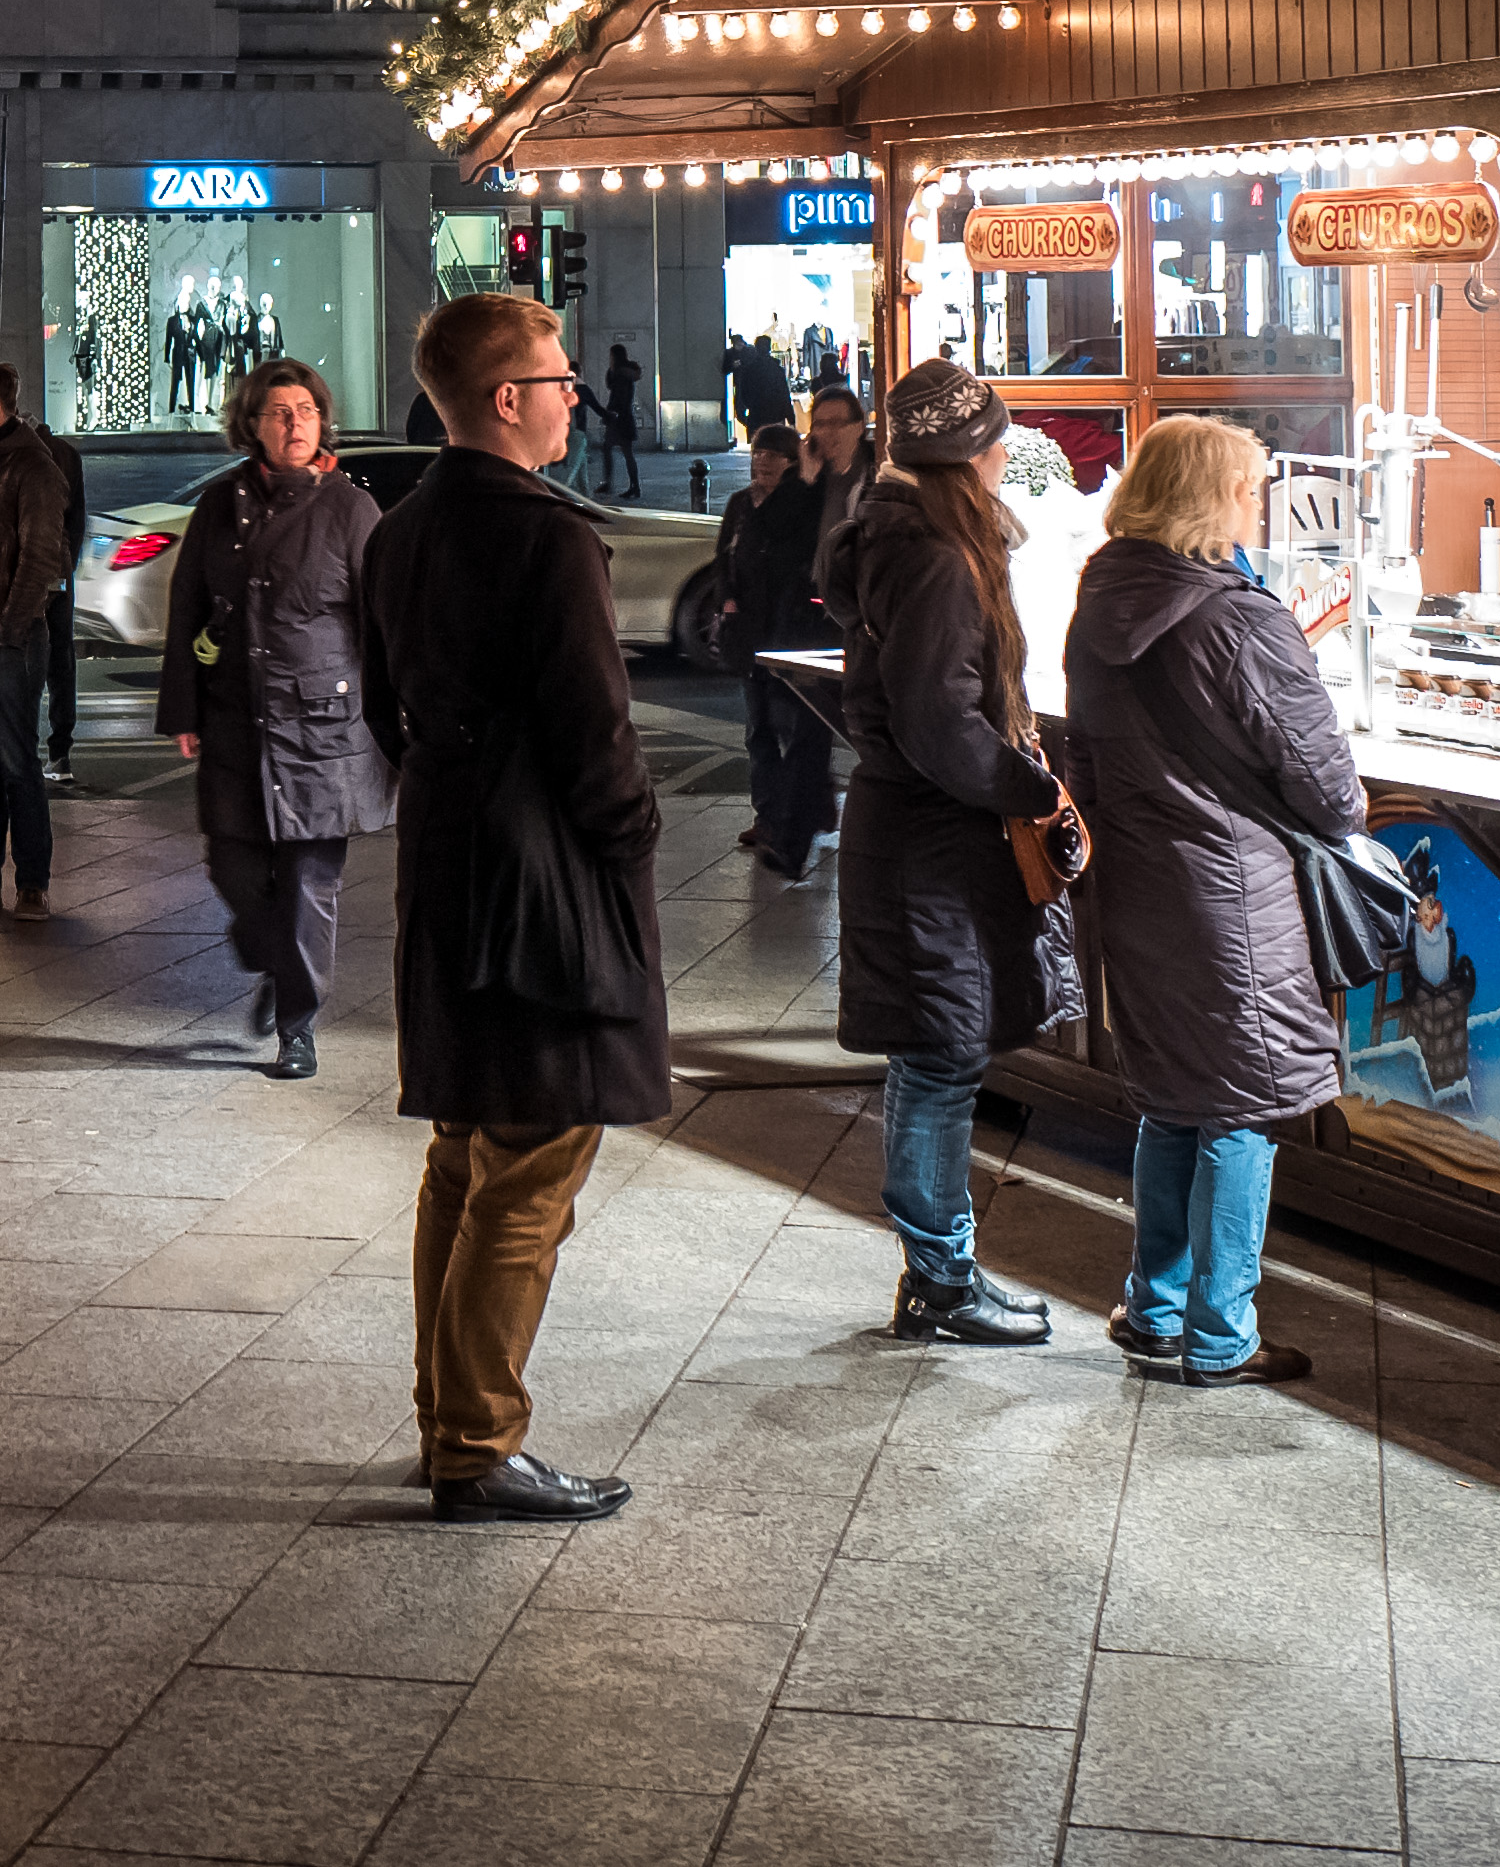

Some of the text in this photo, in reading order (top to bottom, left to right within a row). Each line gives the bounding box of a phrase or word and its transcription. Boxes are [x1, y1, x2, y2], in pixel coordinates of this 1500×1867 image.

[152, 168, 268, 207] ZARA
[986, 215, 1096, 259] CHURROS
[1316, 198, 1463, 250] CHURROS
